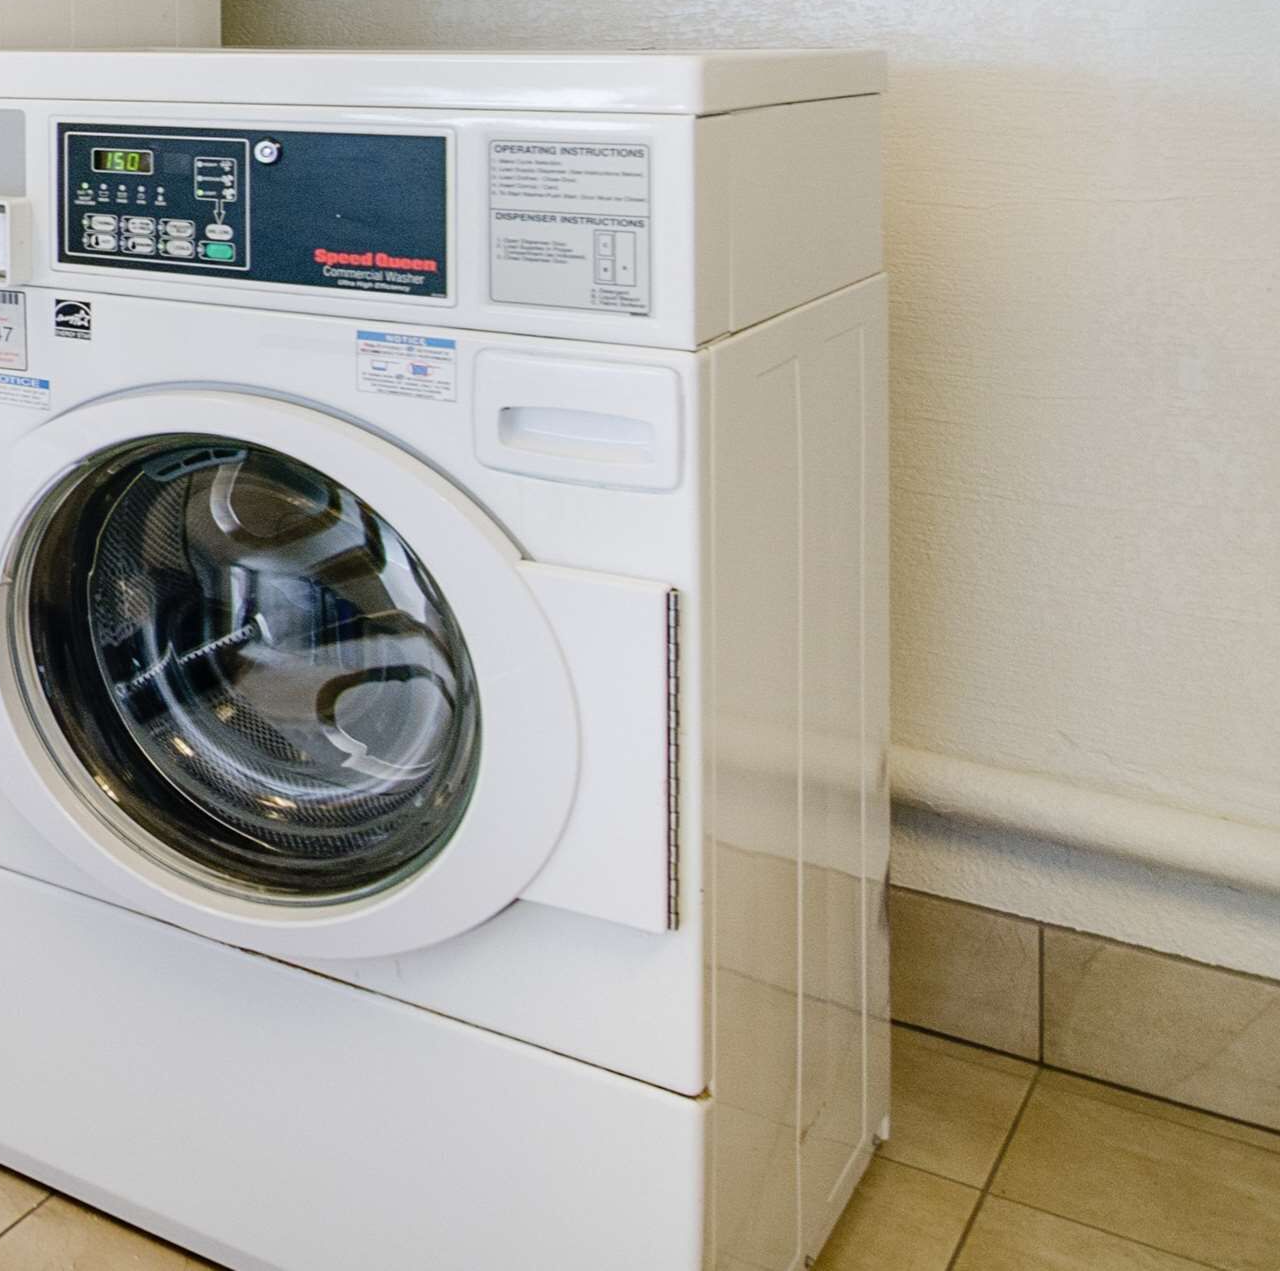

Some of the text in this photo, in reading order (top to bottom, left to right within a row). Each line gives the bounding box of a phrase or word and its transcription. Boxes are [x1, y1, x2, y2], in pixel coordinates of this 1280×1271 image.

[494, 144, 645, 158] OPERATING INSTRUCTIONS
[495, 212, 646, 228] DISPENSER INSTRUCTIONS
[314, 248, 438, 272] Speed Queen
[323, 265, 425, 285] Commercial Washer
